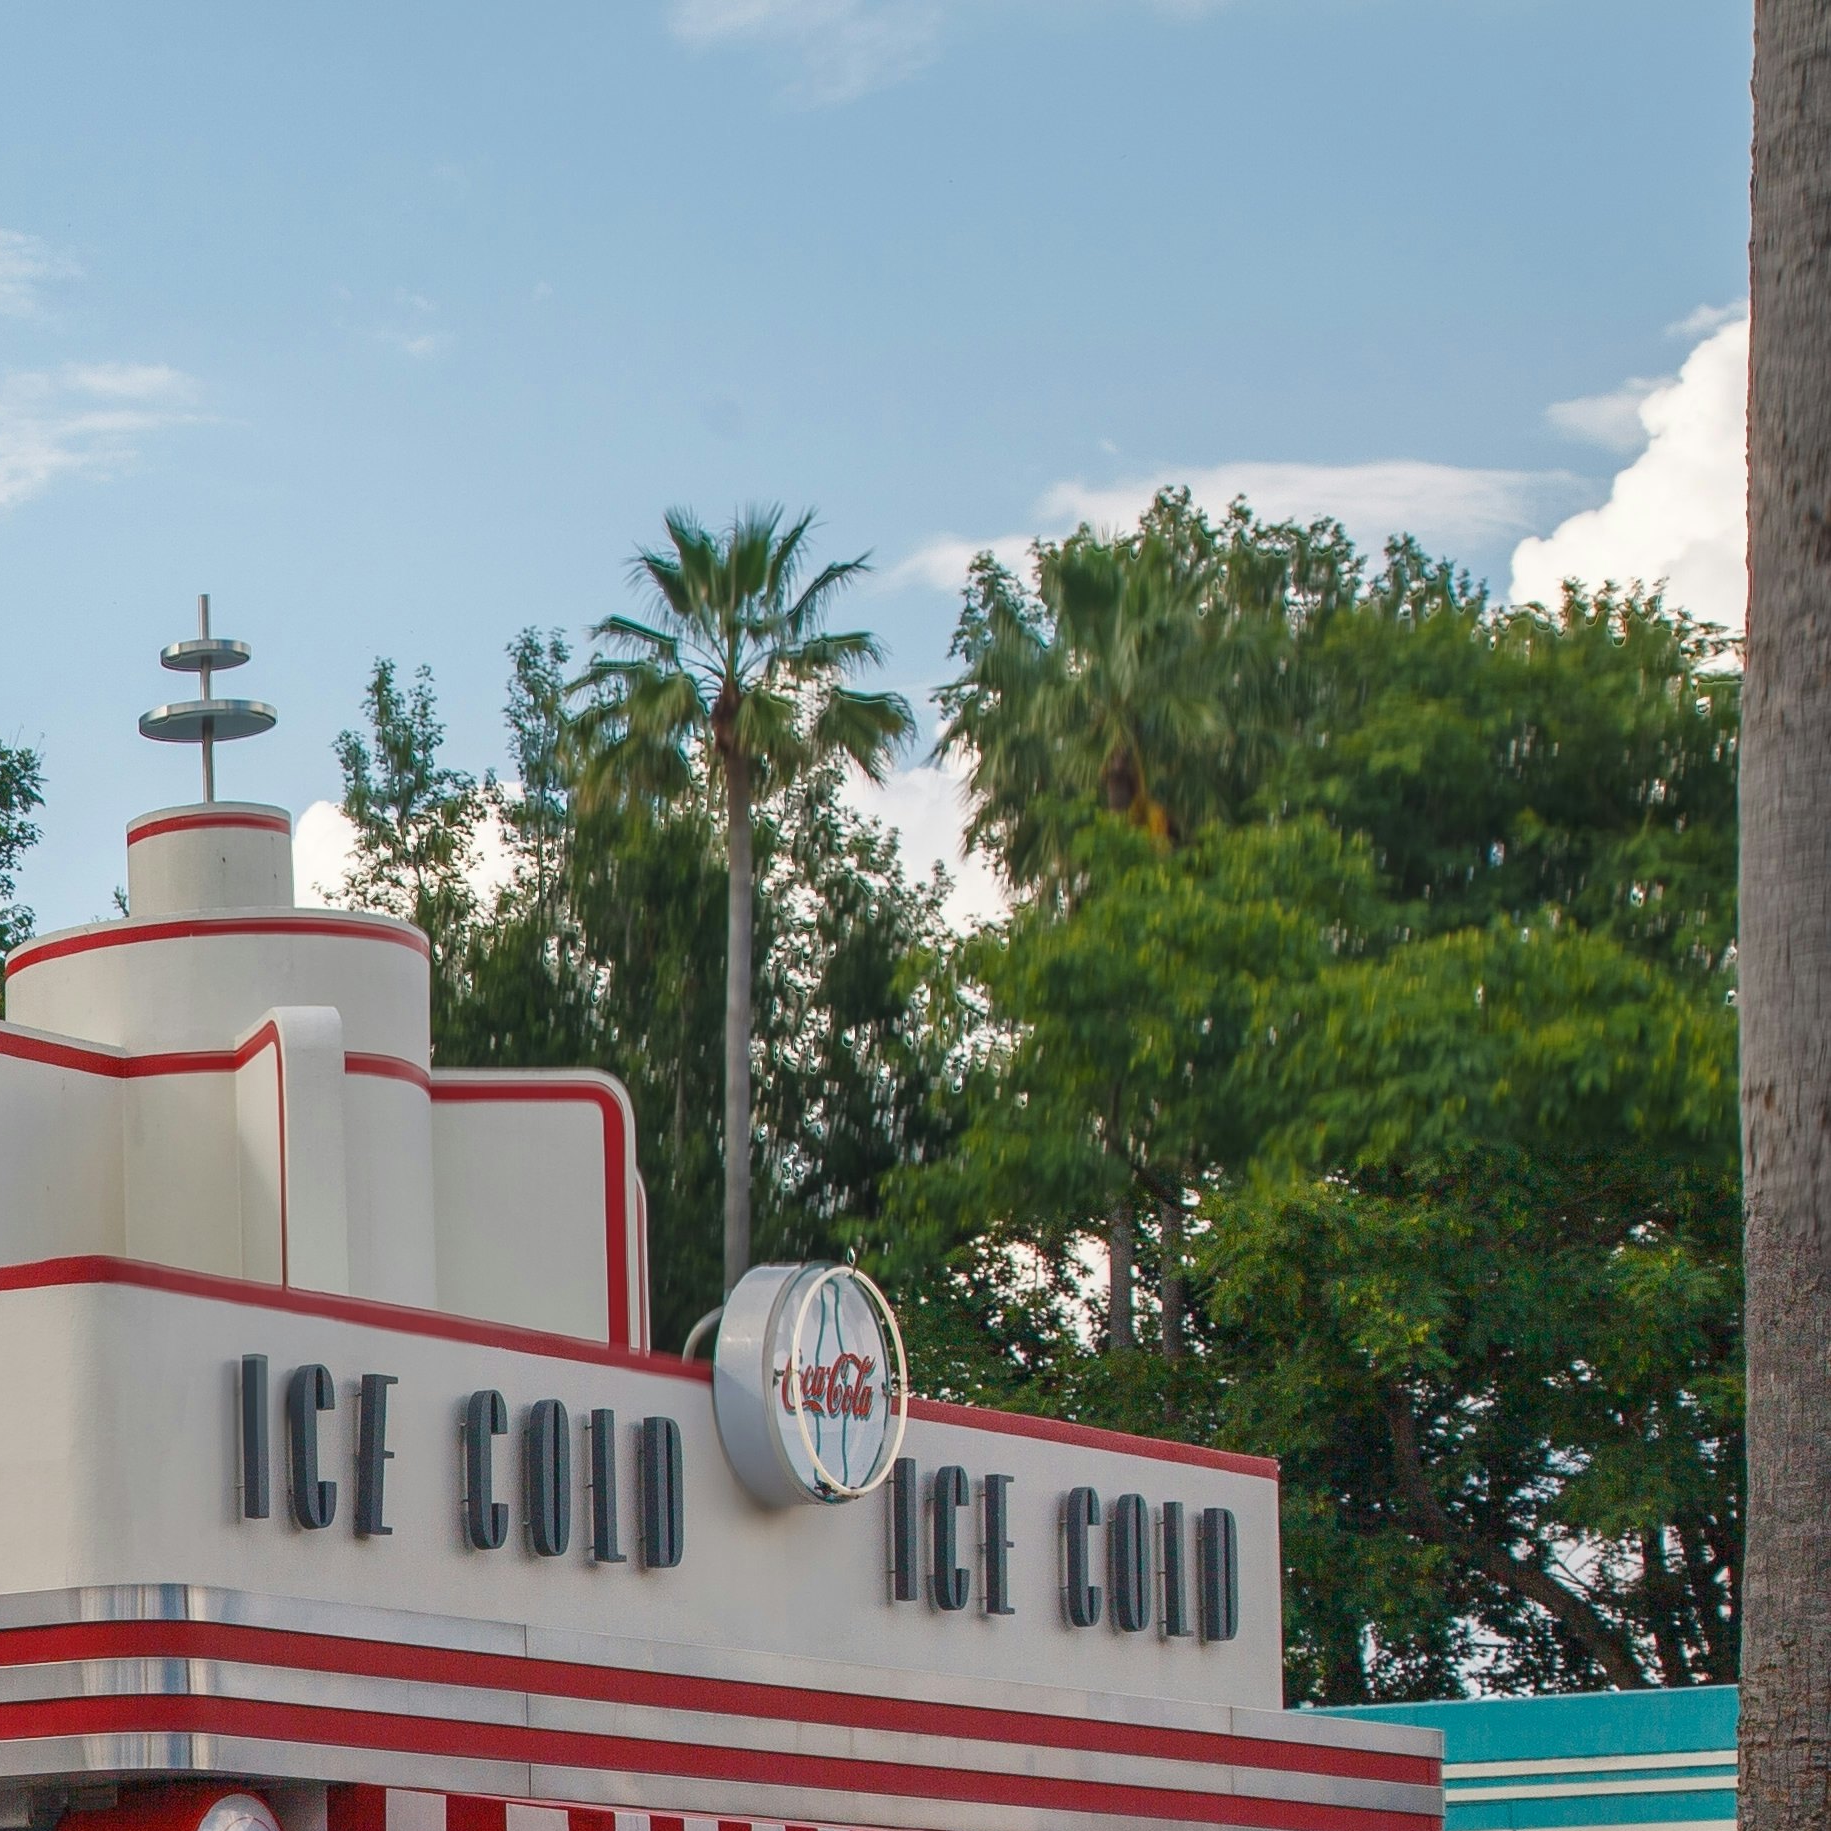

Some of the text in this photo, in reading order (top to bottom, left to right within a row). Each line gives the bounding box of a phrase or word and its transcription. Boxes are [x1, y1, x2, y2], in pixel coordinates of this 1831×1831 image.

[241, 1354, 684, 1569] ICE COLD
[892, 1456, 1238, 1642] ICE COLD
